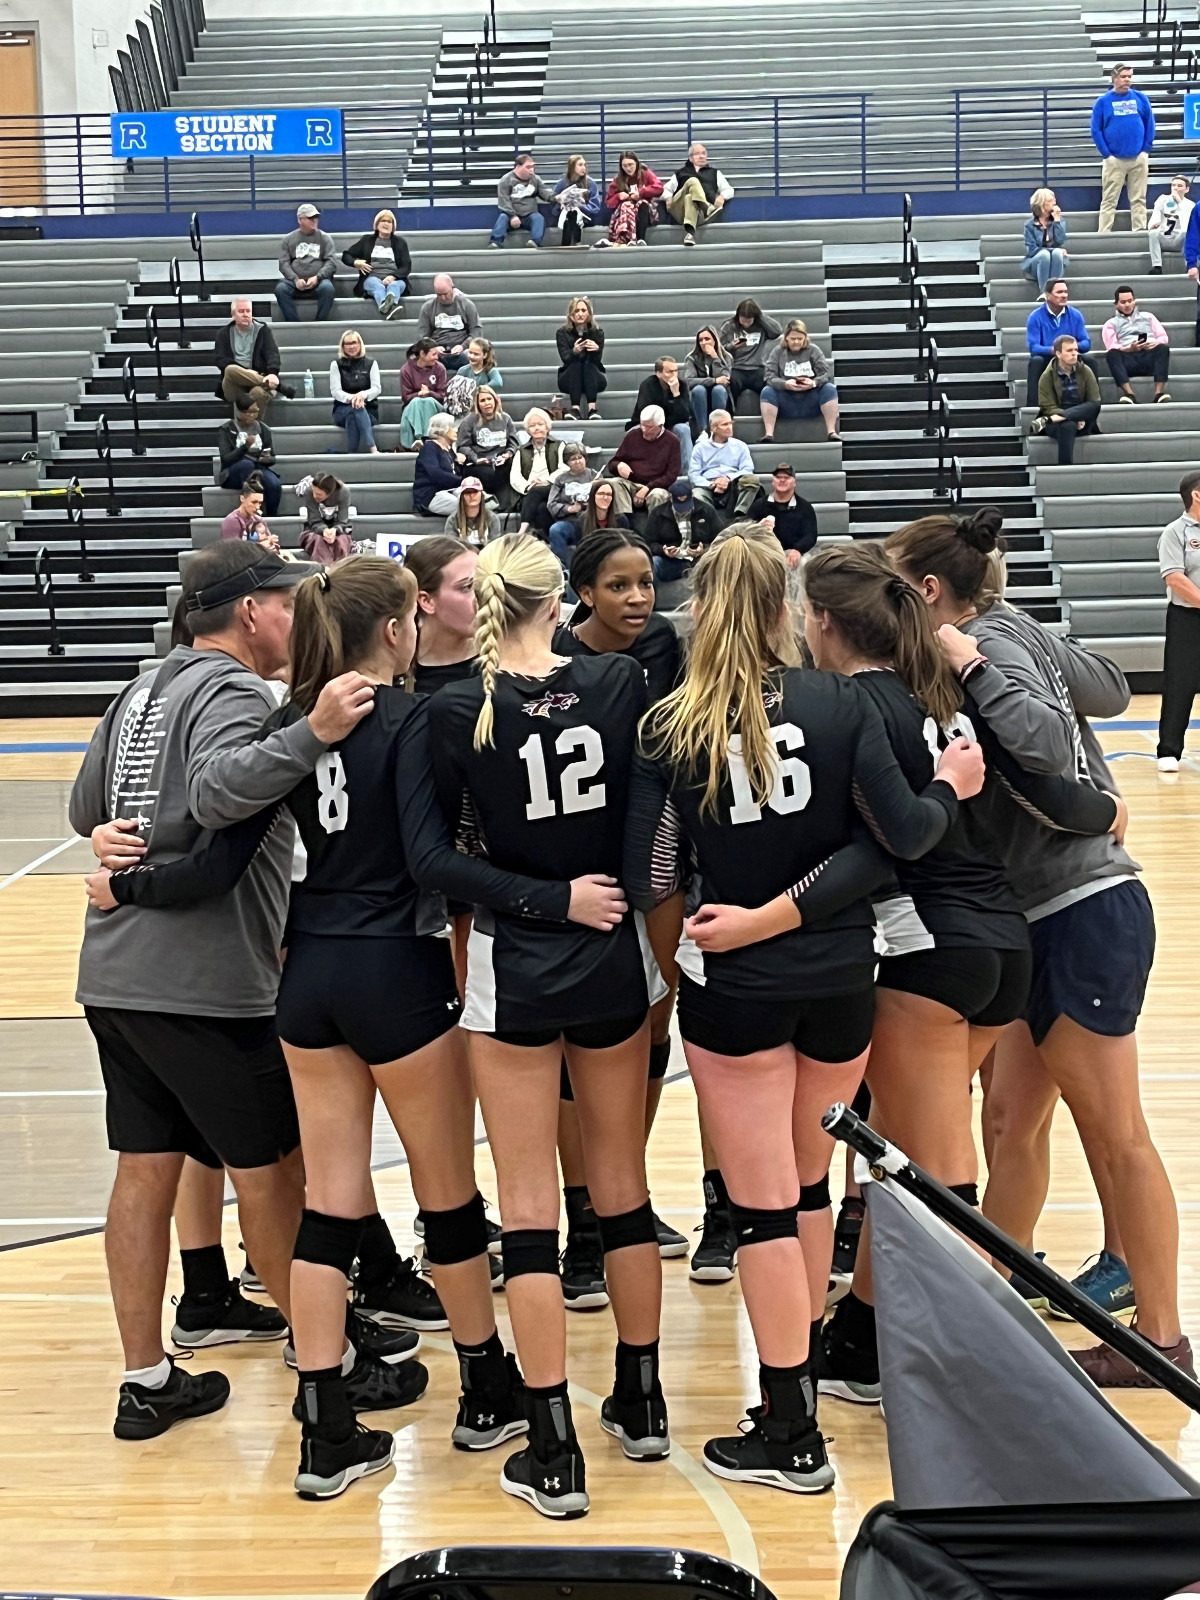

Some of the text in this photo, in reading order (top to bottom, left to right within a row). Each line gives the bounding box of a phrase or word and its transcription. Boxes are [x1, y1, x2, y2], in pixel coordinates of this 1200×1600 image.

[120, 122, 147, 149] R
[175, 115, 277, 133] STUDENT
[306, 118, 333, 146] R
[180, 134, 273, 152] SECTION
[1164, 218, 1176, 235] 7
[518, 725, 606, 821] 12
[727, 722, 812, 825] 16
[315, 751, 348, 834] 8
